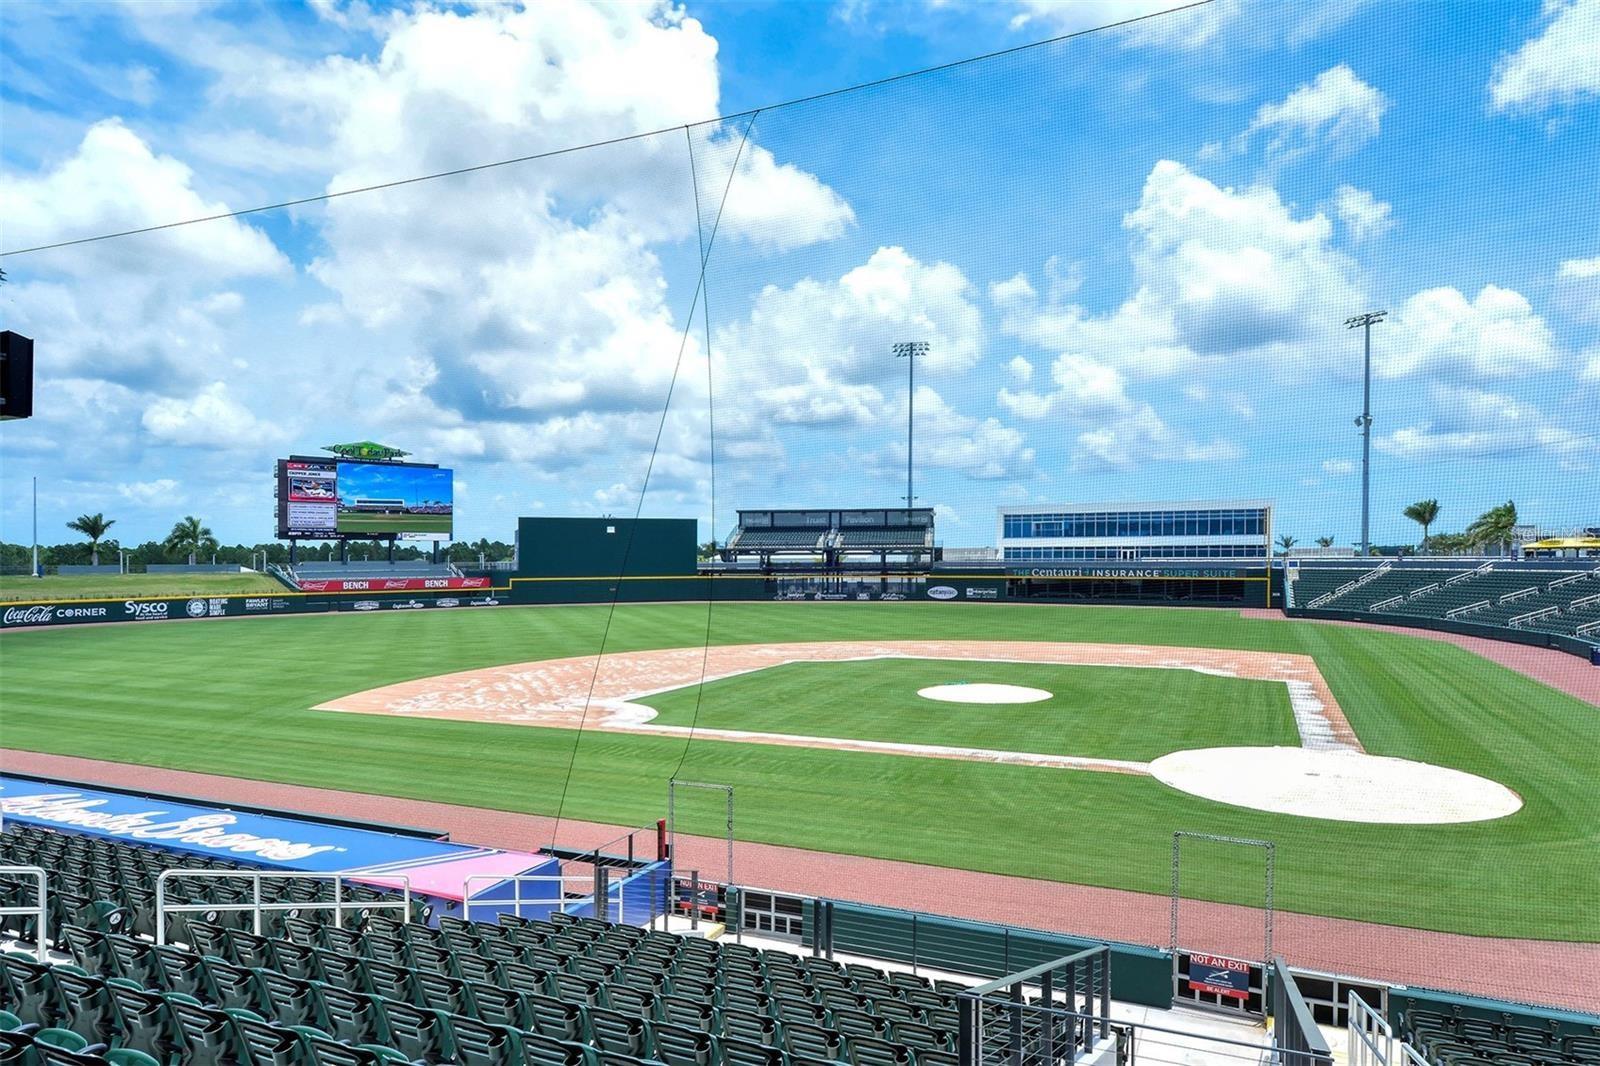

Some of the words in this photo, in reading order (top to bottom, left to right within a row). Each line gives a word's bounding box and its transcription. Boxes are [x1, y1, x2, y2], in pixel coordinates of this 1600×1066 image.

[1032, 566, 1082, 577] Centauri
[1092, 569, 1160, 577] INSURANCE
[1163, 569, 1199, 577] SUPER
[1203, 569, 1236, 577] SUITE
[342, 581, 368, 590] BENCH
[424, 579, 447, 588] BENCH
[125, 600, 167, 616] Sysco
[1190, 954, 1209, 964] NOT
[1211, 958, 1225, 968] AN
[1228, 961, 1248, 971] EXIT
[1214, 987, 1230, 995] ALERT
